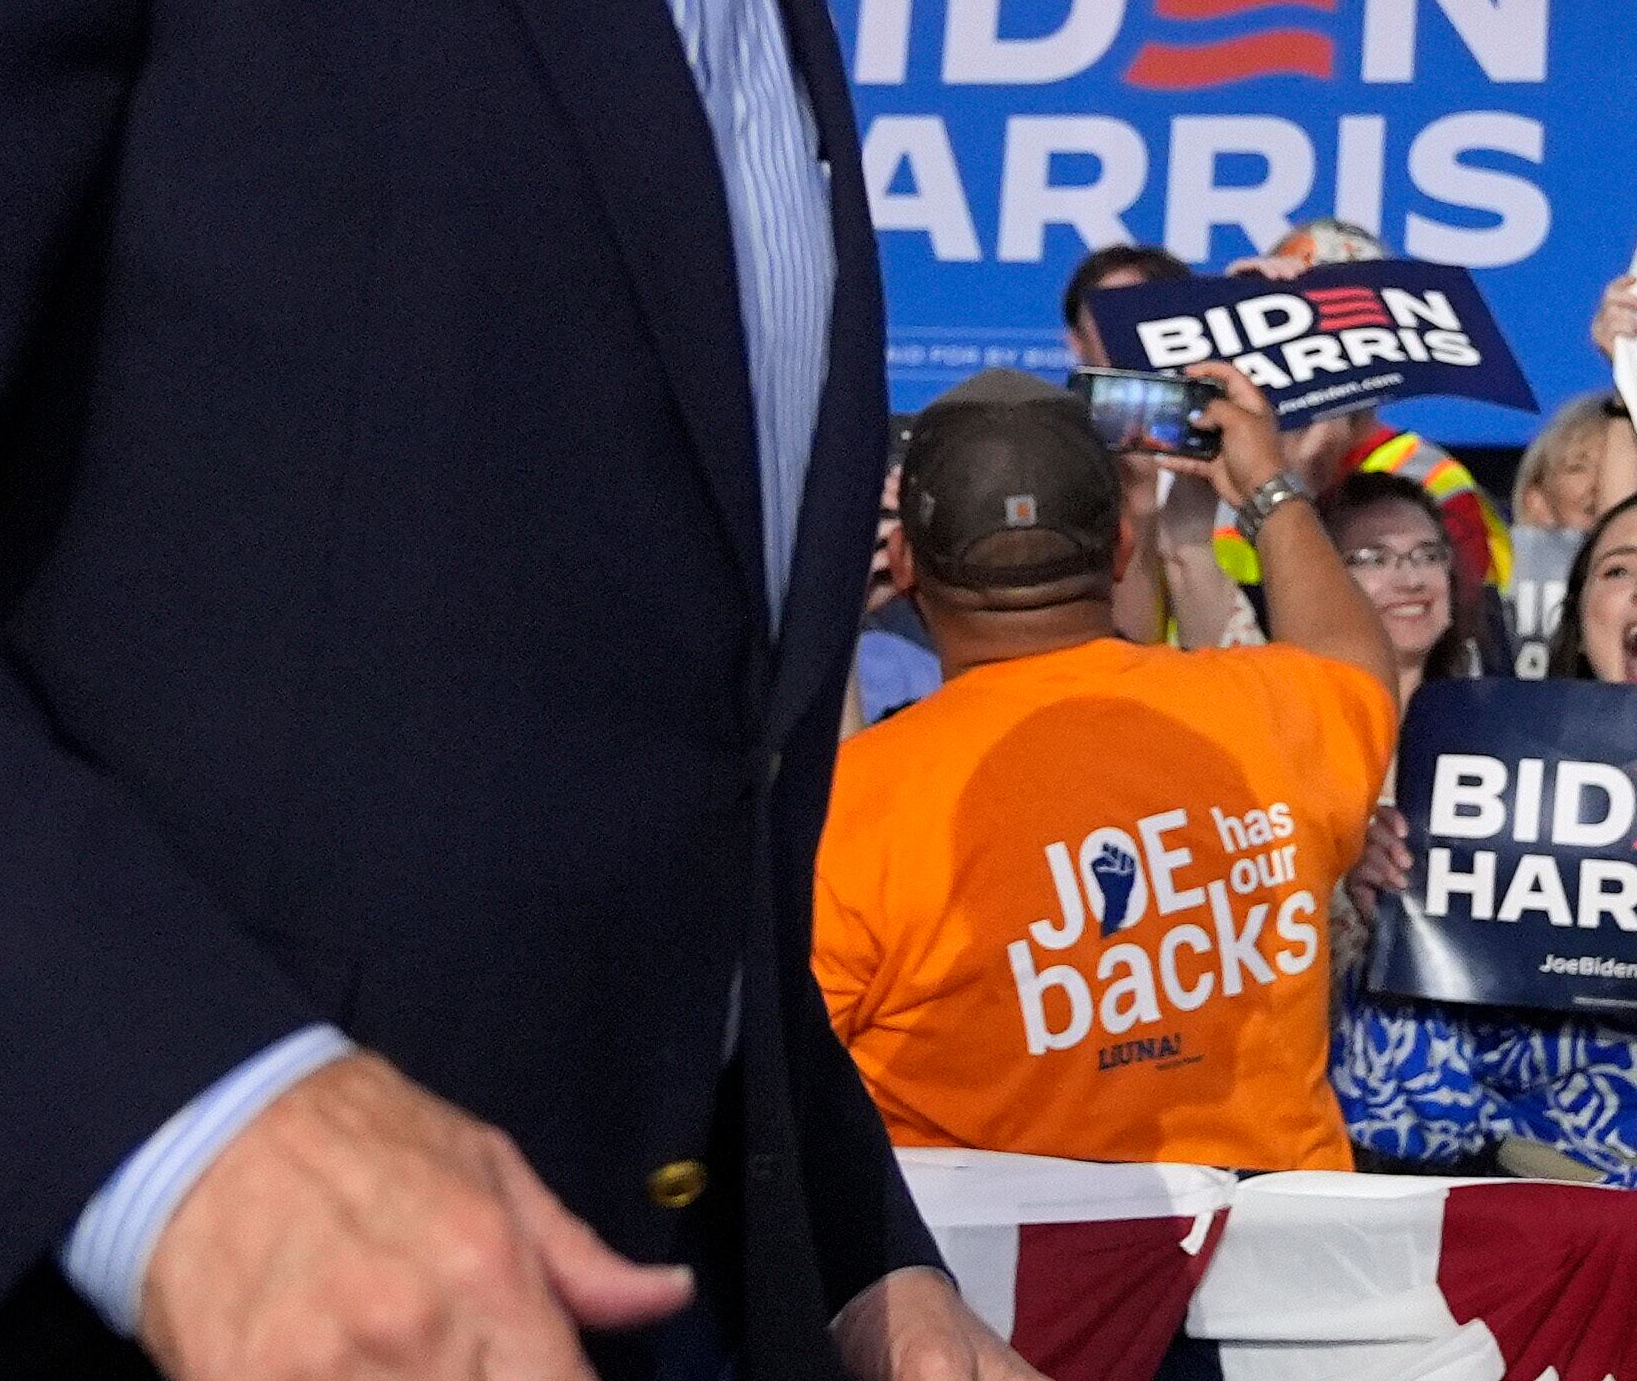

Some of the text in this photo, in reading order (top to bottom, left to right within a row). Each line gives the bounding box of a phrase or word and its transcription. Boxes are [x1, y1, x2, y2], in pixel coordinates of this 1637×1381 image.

[861, 109, 1554, 269] ARRIS
[1135, 286, 1464, 370] BIDEN
[1231, 326, 1482, 390] ARRIS
[1028, 801, 1295, 950] JOE has
[1229, 843, 1298, 895] our
[1007, 878, 1319, 1056] backs
